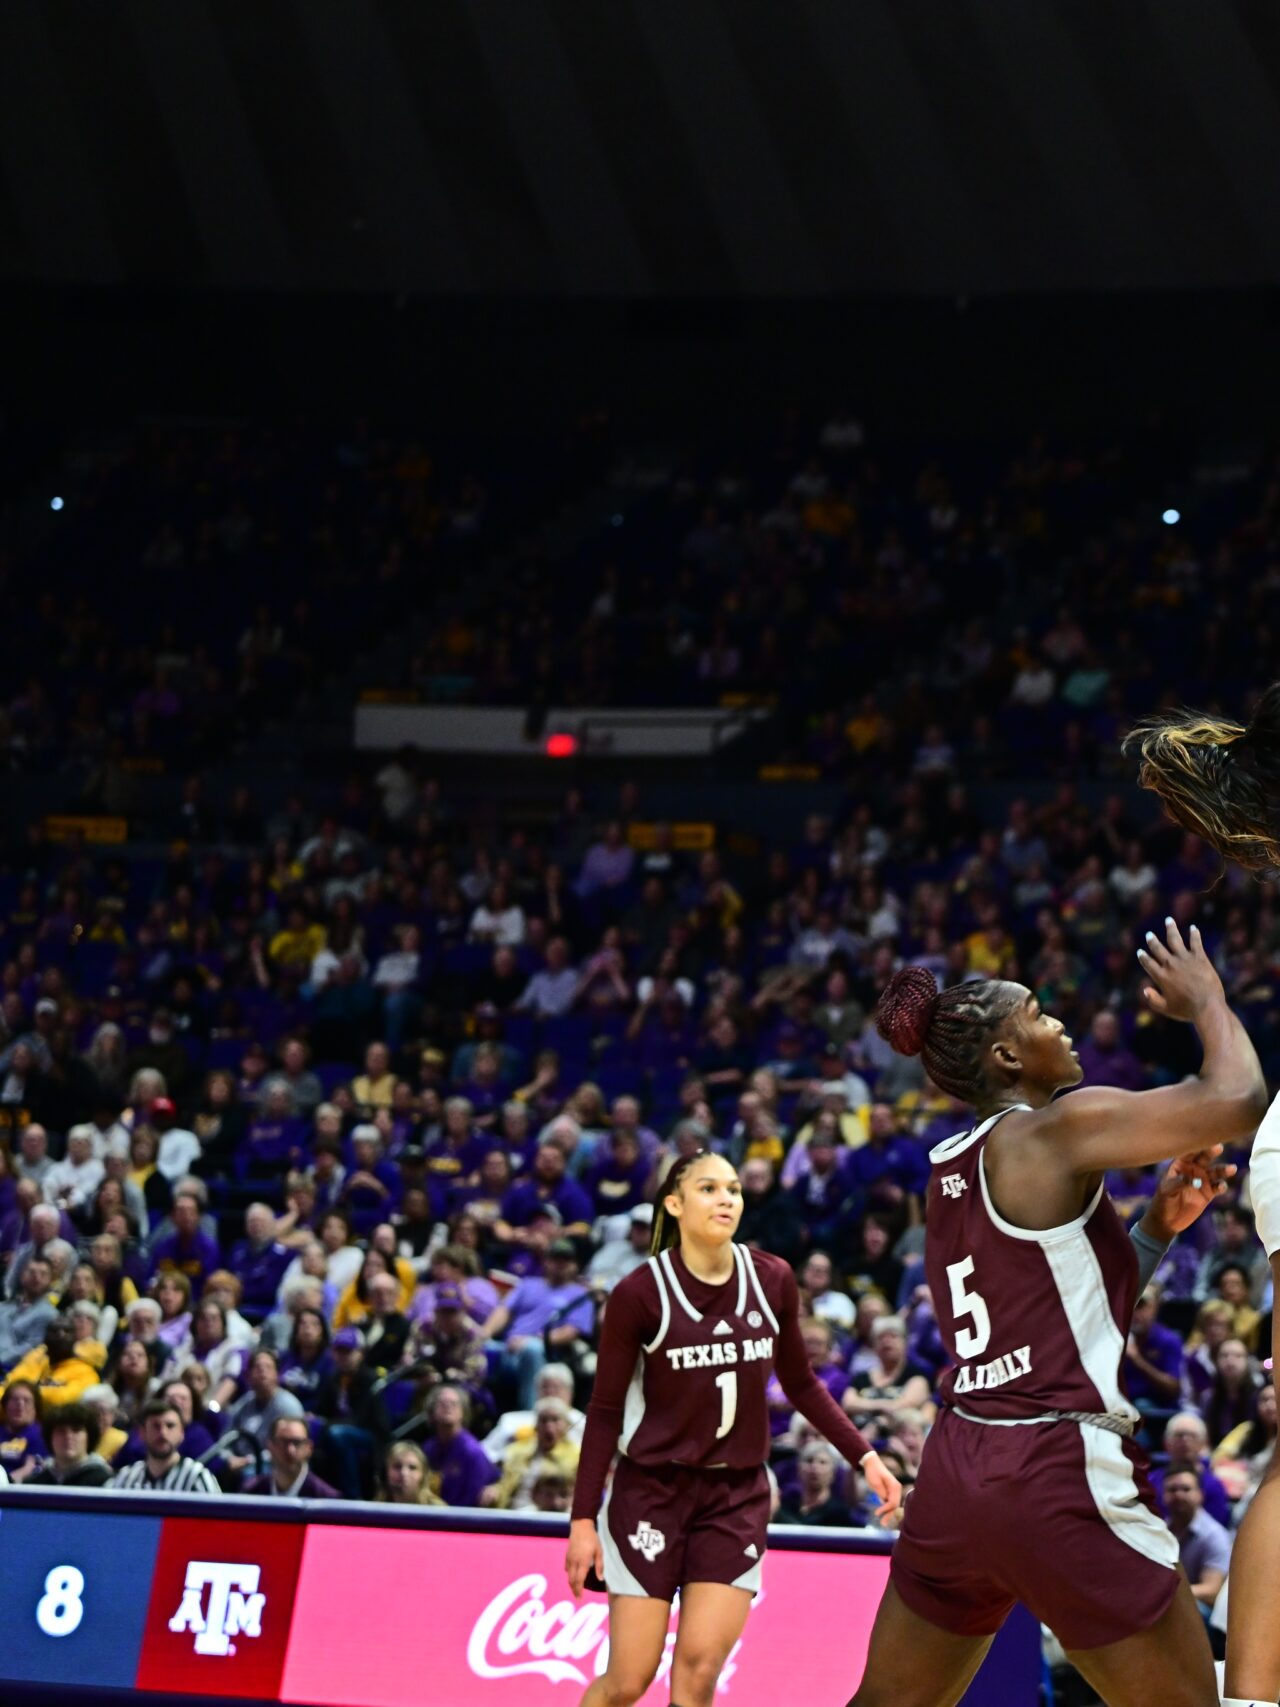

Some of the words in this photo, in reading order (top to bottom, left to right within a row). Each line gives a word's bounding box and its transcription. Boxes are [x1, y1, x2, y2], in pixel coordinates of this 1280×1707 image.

[945, 1254, 991, 1360] 5
[666, 1342, 738, 1370] TEXAS
[742, 1337, 773, 1362] A&M
[715, 1370, 738, 1440] 1
[36, 1565, 85, 1637] 8
